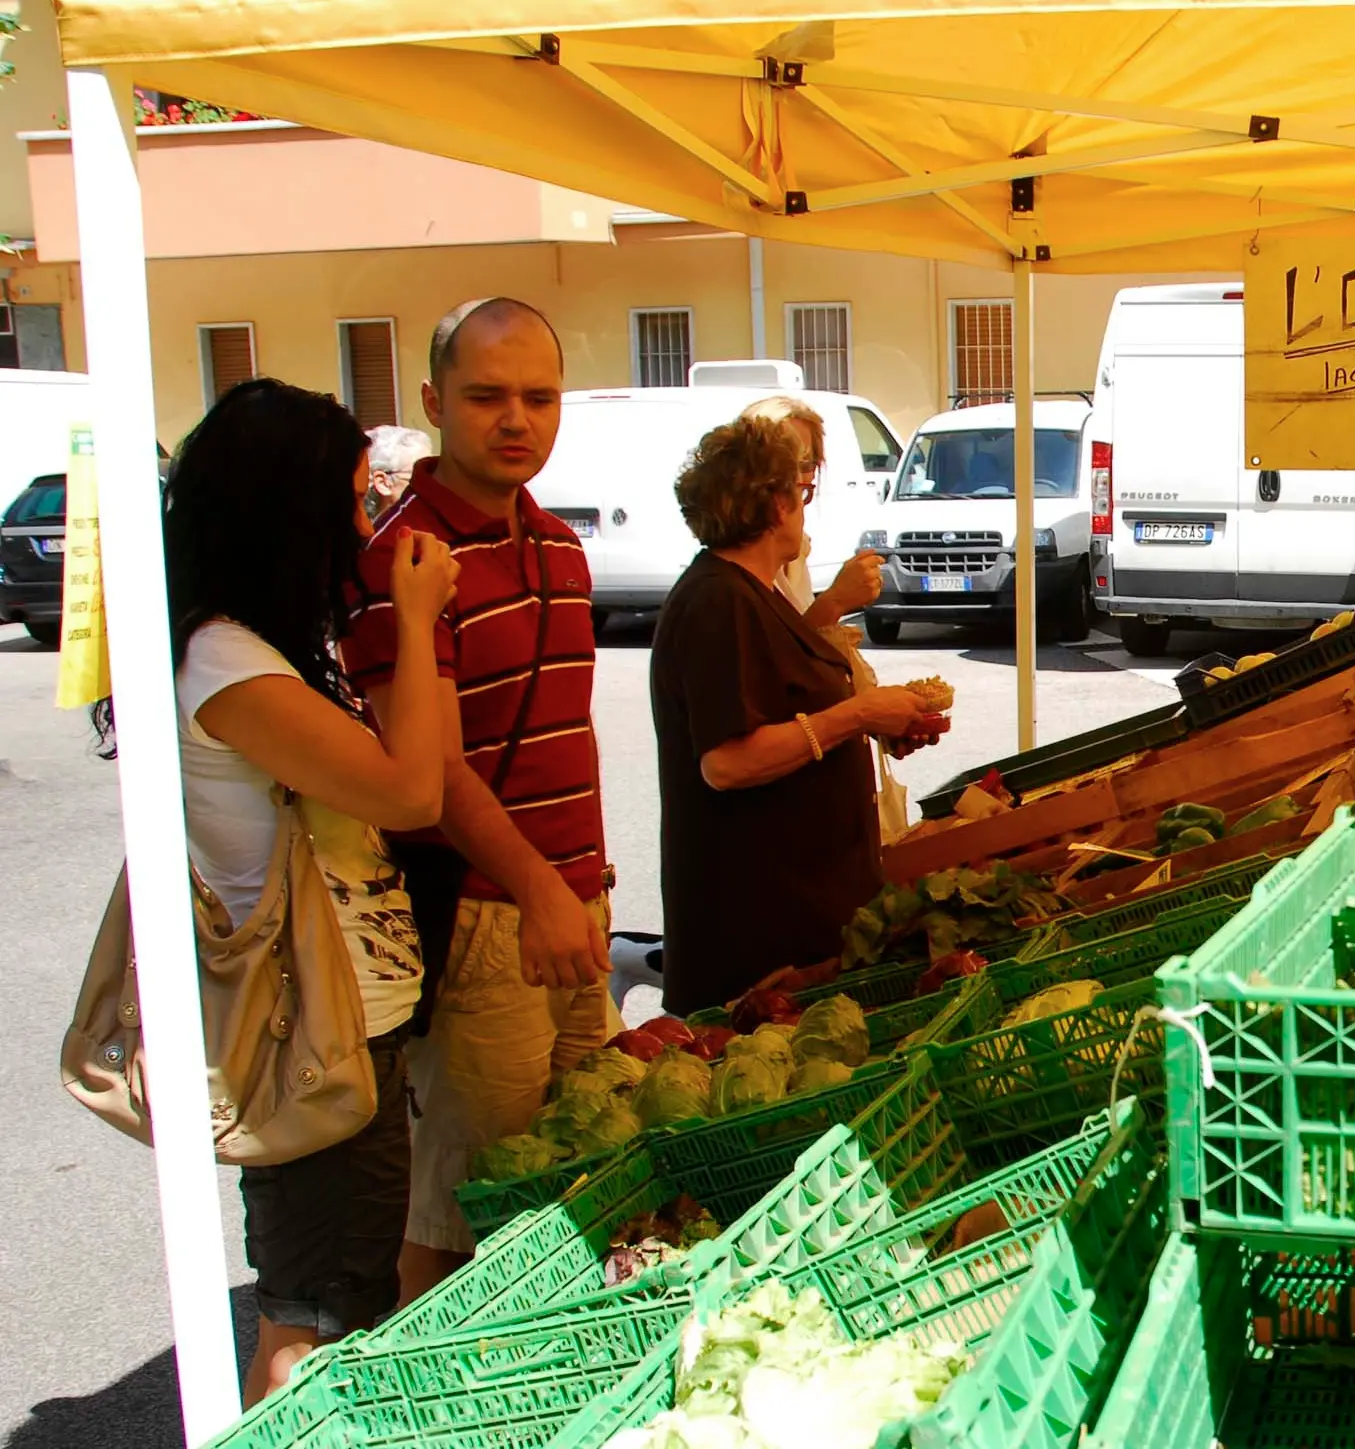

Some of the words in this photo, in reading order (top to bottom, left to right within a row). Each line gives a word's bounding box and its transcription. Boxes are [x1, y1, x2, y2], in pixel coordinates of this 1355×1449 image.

[1120, 491, 1179, 500] PEUGEOT
[1144, 524, 1160, 538] DP
[1165, 525, 1205, 539] 726AS
